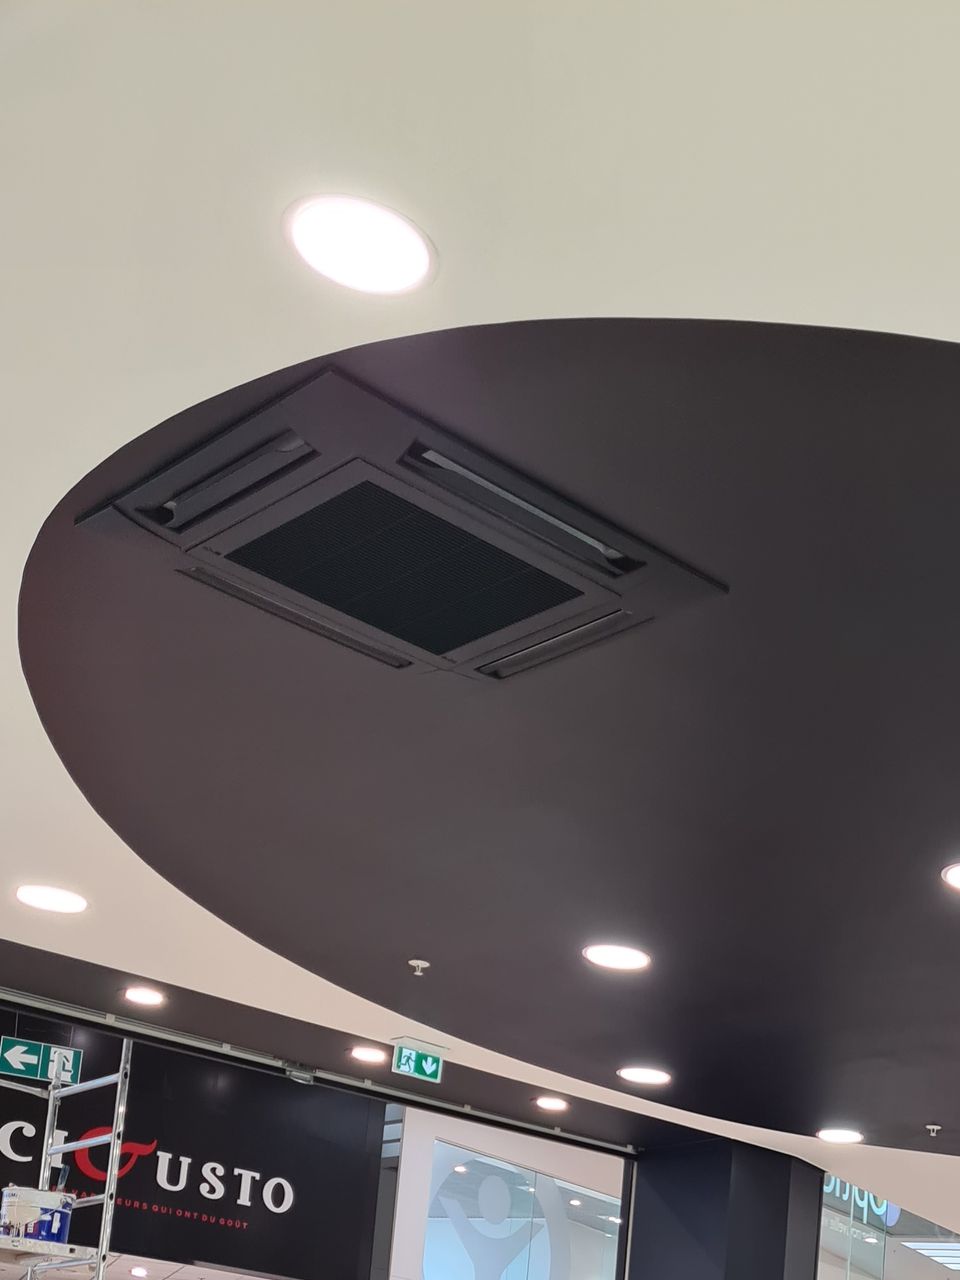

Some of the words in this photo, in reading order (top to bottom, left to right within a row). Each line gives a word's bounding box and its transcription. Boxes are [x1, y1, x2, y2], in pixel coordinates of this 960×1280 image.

[151, 1203, 173, 1215] QUI
[175, 1208, 199, 1219] ONT
[201, 1213, 216, 1224] DU
[218, 1217, 249, 1230] GOÛT
